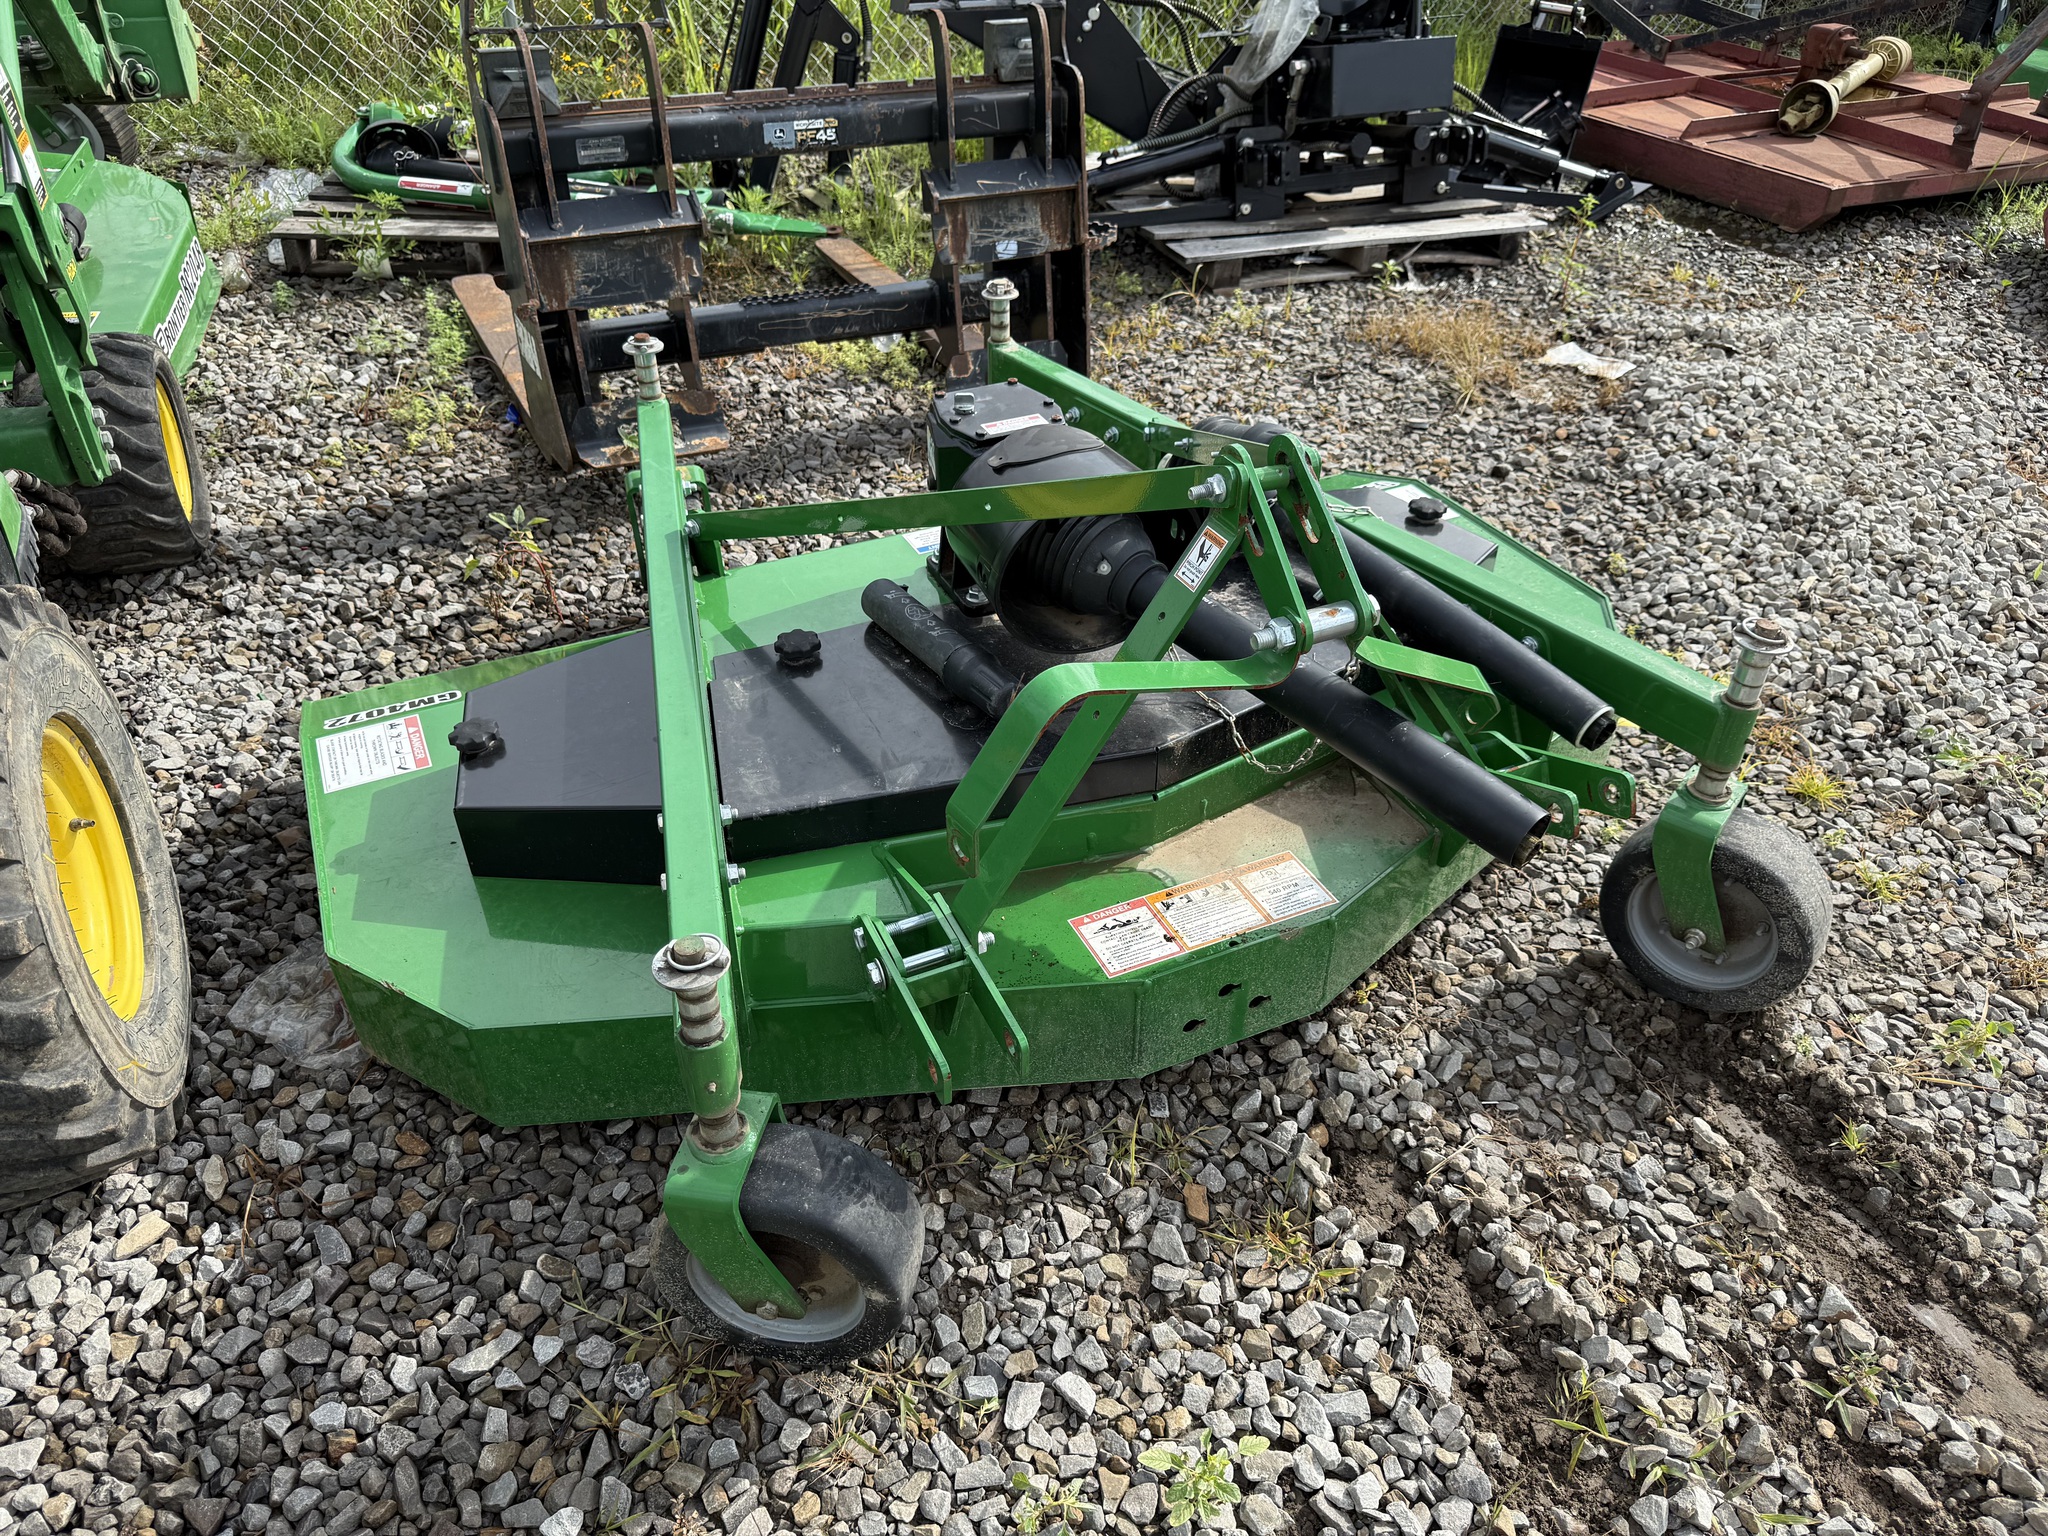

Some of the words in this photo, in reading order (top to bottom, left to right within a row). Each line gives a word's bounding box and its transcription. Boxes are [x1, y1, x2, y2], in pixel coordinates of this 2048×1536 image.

[326, 690, 458, 729] GM4072
[409, 732, 425, 759] DANGER
[1245, 855, 1286, 871] WARNING
[1281, 882, 1300, 890] RPM
[1092, 904, 1132, 919] DANGER
